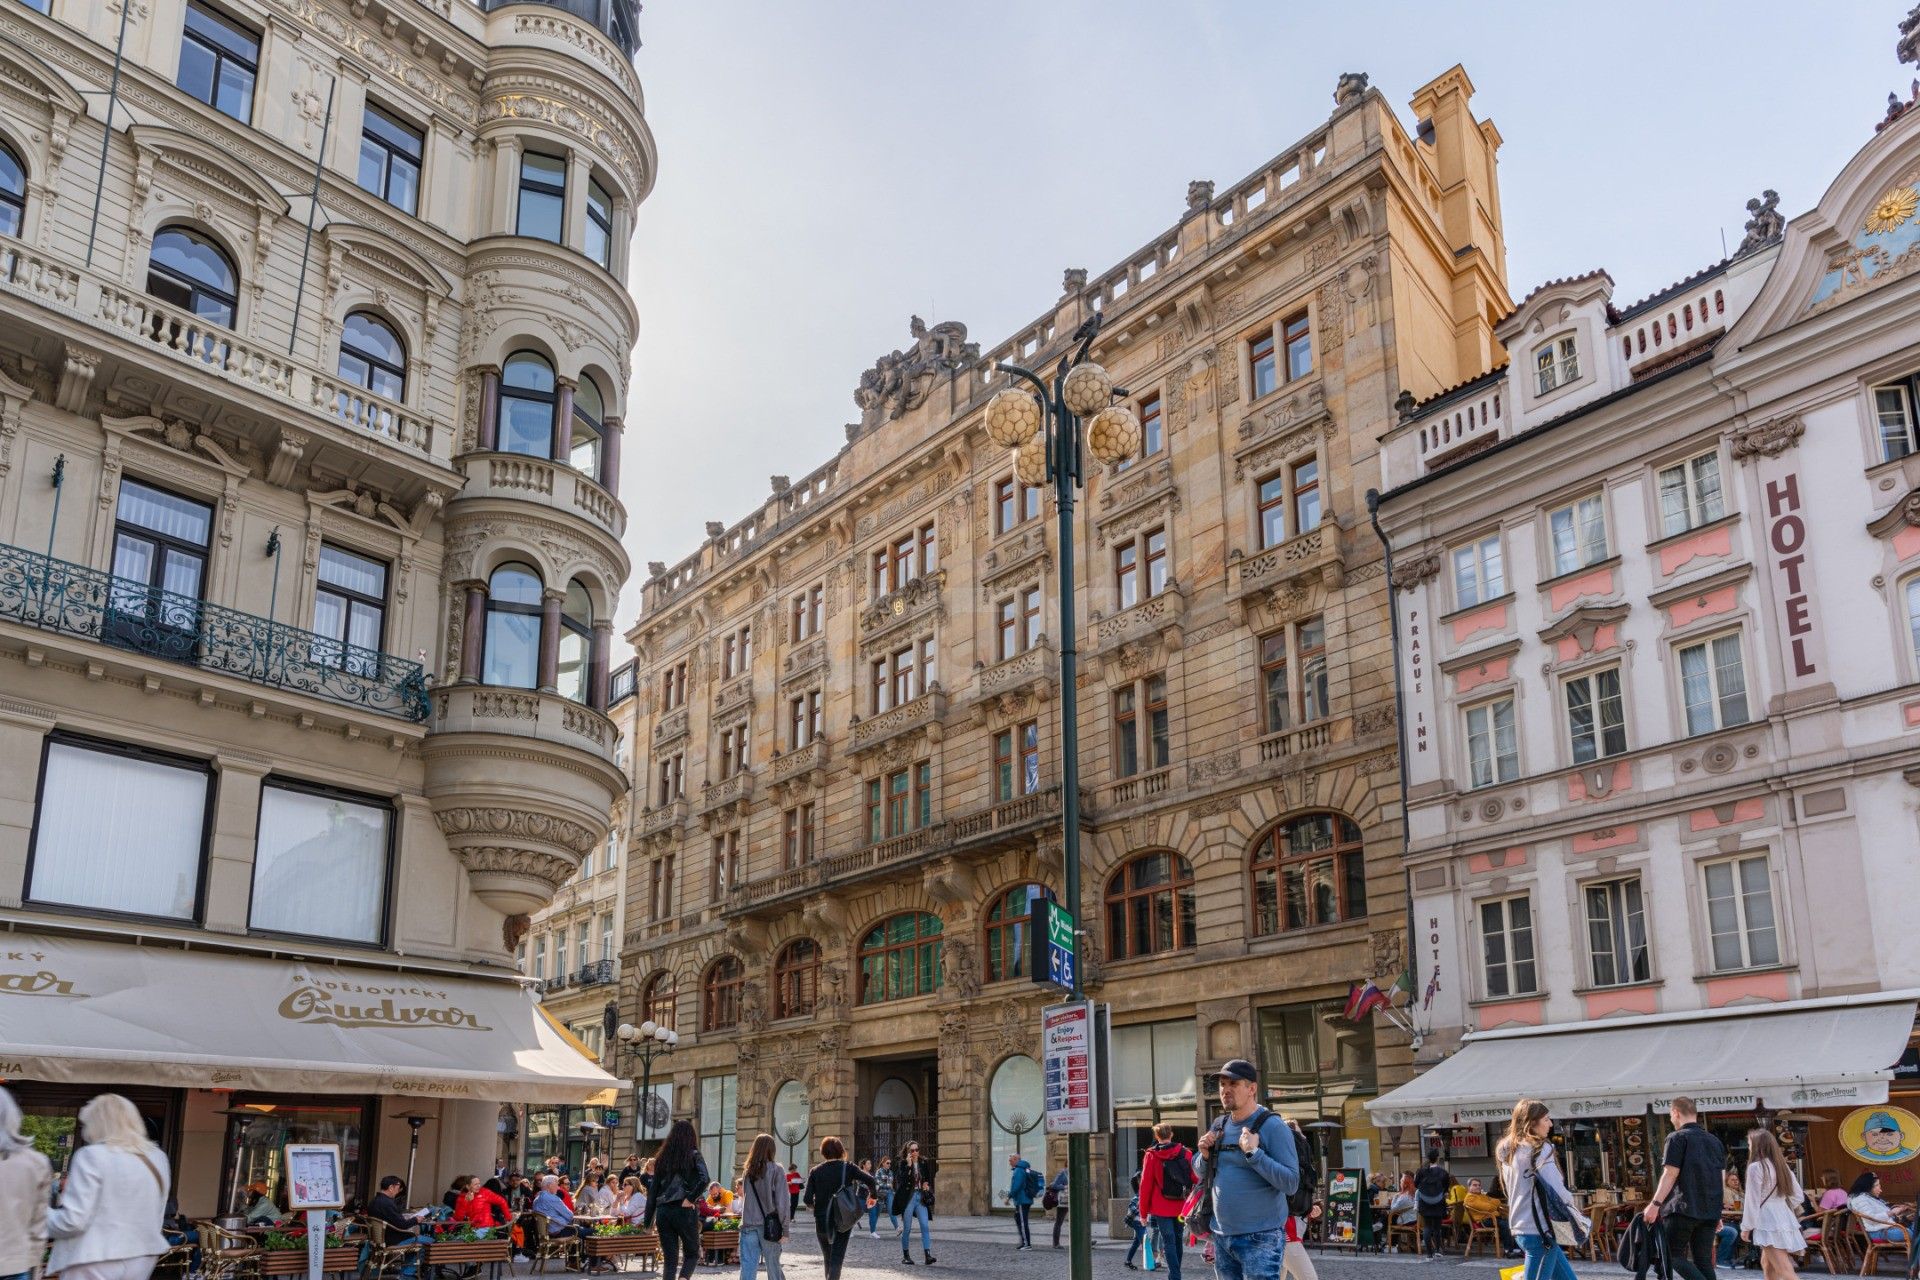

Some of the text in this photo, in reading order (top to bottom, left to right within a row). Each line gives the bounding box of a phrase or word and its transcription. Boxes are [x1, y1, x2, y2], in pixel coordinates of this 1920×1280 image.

[1766, 473, 1816, 677] HOTEL
[1410, 611, 1428, 753] PRAGUE INN
[1429, 917, 1442, 992] HOTEL
[292, 974, 449, 1000] BUDĚJOVICKÝ
[277, 985, 494, 1032] Budvar
[1057, 1026, 1075, 1035] Enjoy
[1057, 1034, 1083, 1044] Respect
[428, 1082, 469, 1094] PRAHA
[1654, 1095, 1754, 1108] ŠVE ESTAURANT
[1486, 1108, 1513, 1118] RESTA
